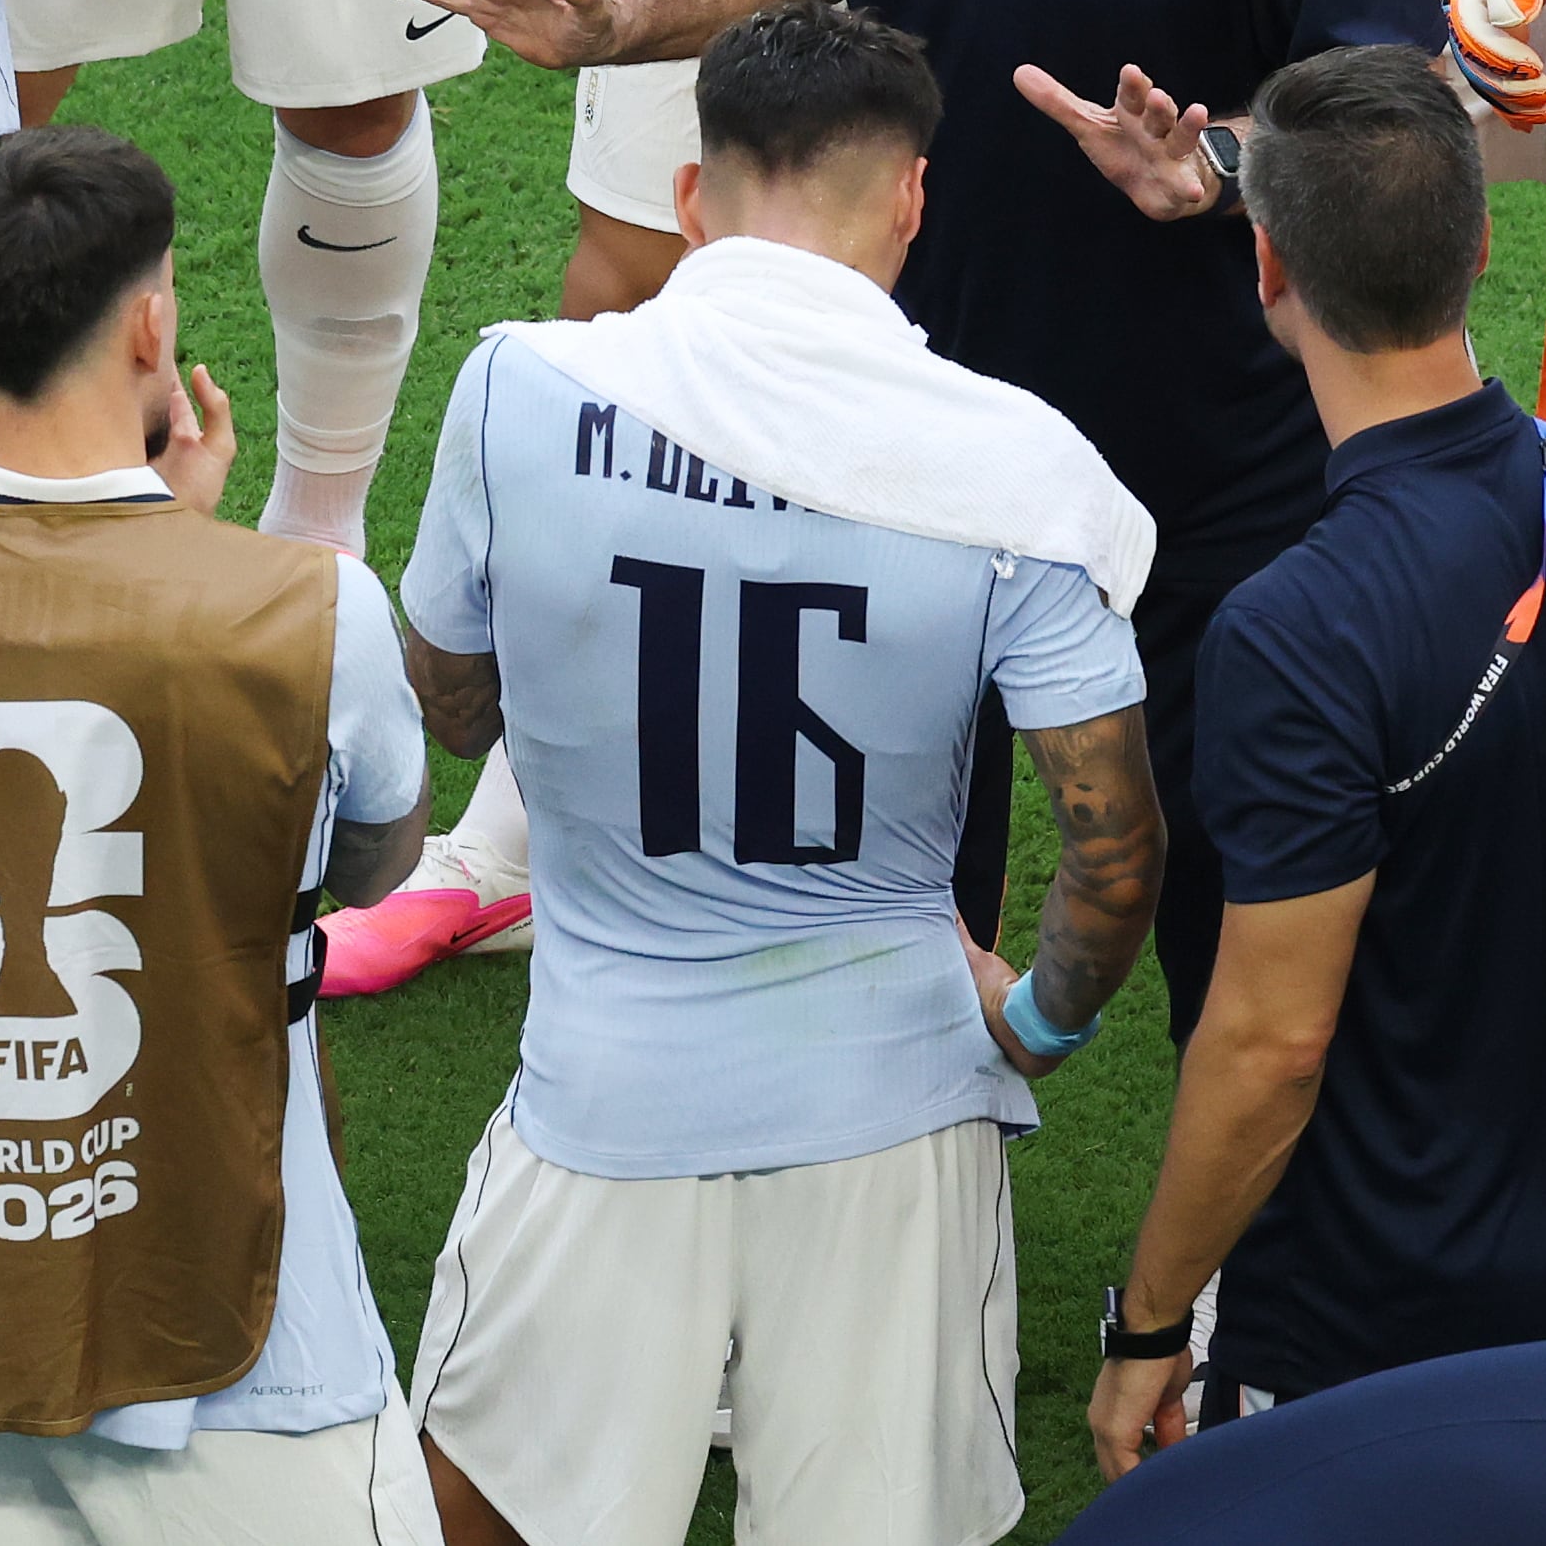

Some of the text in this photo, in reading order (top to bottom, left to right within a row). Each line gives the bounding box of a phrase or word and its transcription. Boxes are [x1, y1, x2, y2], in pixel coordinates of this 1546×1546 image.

[575, 401, 632, 481] M.
[611, 555, 868, 865] 16
[1413, 653, 1509, 783] FIFA WORLD CUP
[82, 1116, 141, 1166] CUP
[250, 1383, 325, 1397] AERO-FIT
